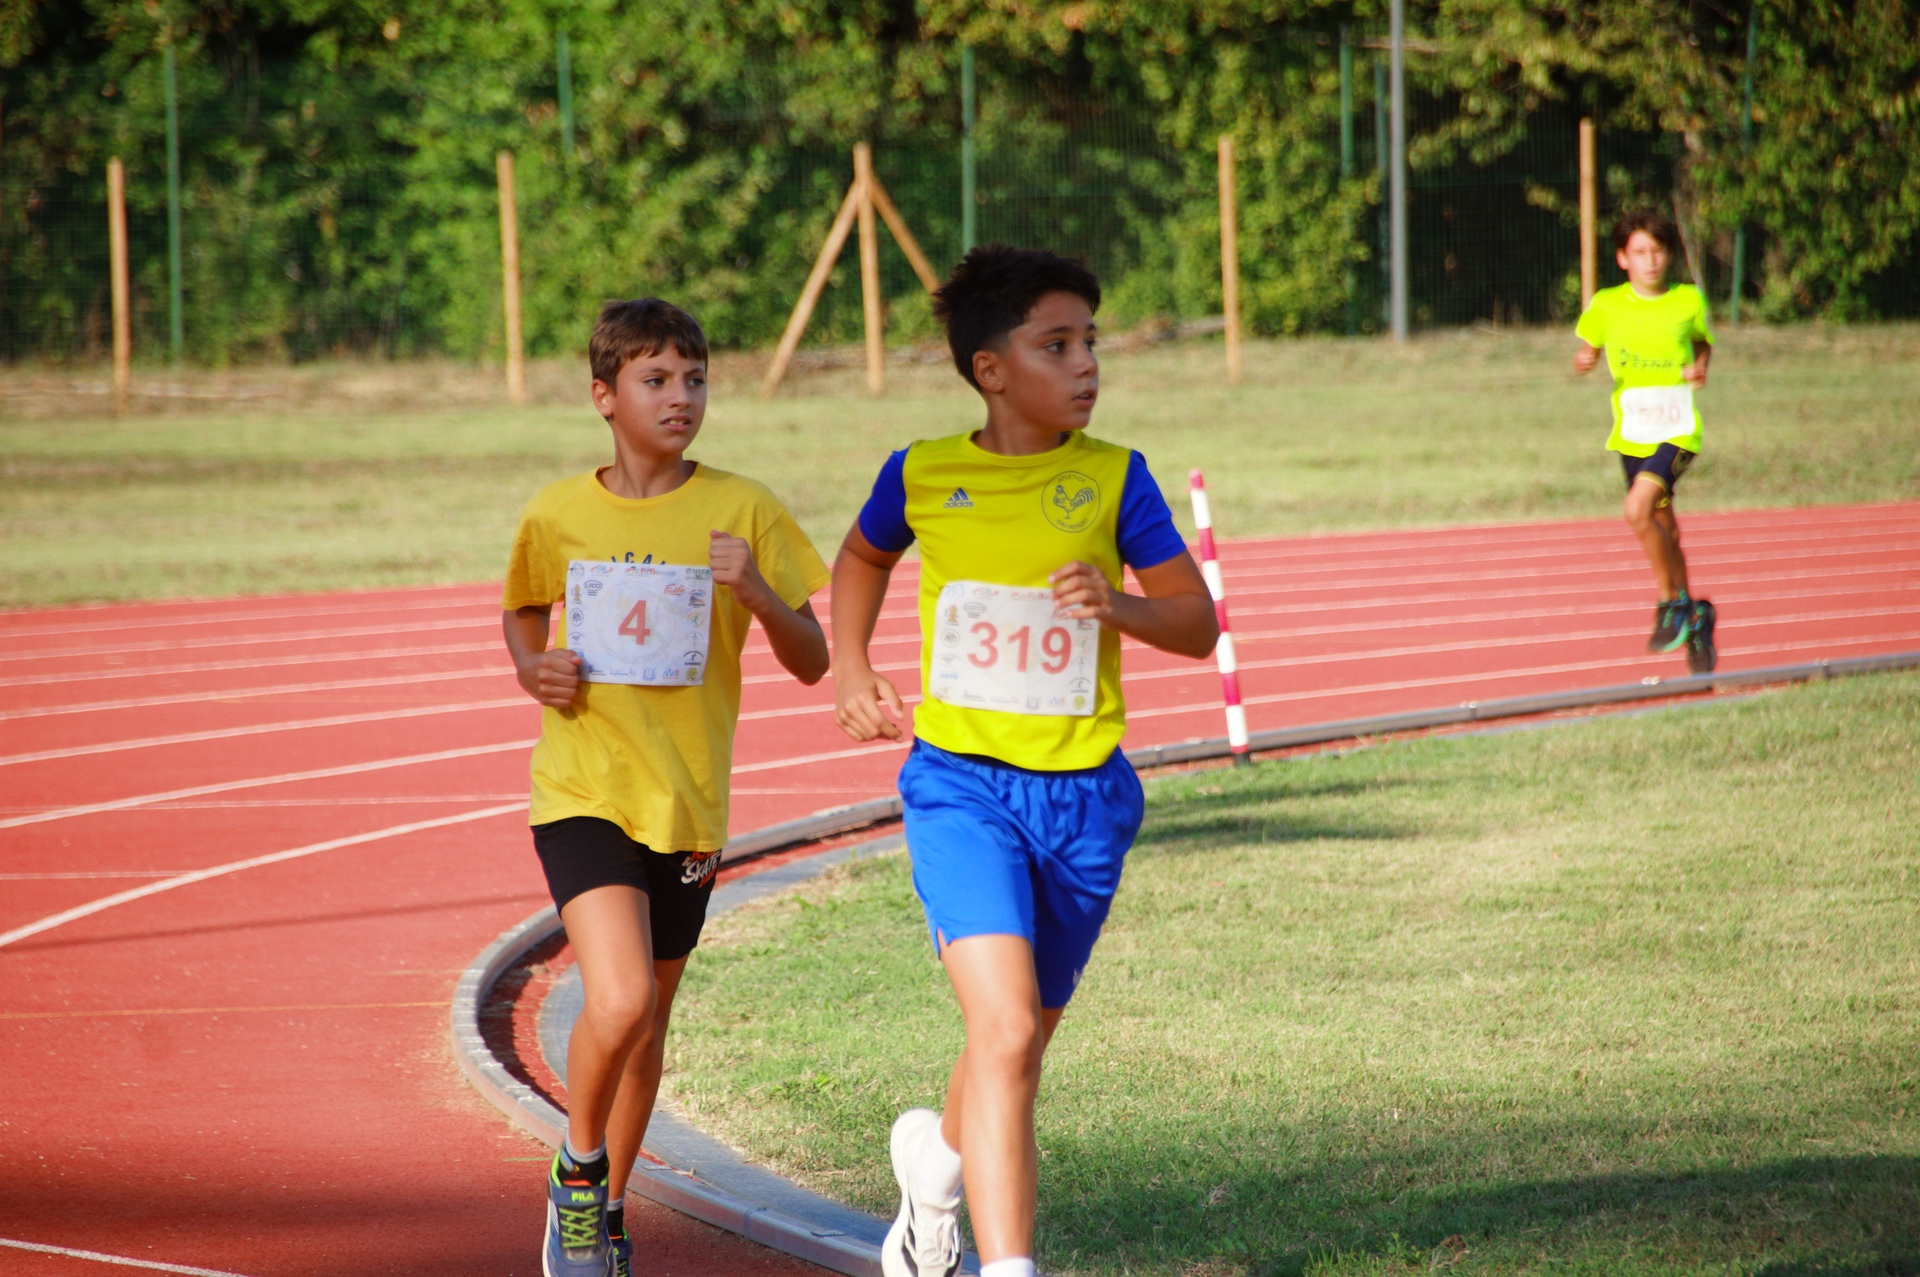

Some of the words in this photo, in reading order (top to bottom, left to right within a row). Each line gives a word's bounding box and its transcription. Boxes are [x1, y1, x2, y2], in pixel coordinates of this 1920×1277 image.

[943, 500, 974, 509] adidas
[618, 600, 650, 645] 4
[967, 622, 1073, 674] 319
[571, 1192, 594, 1202] FILA
